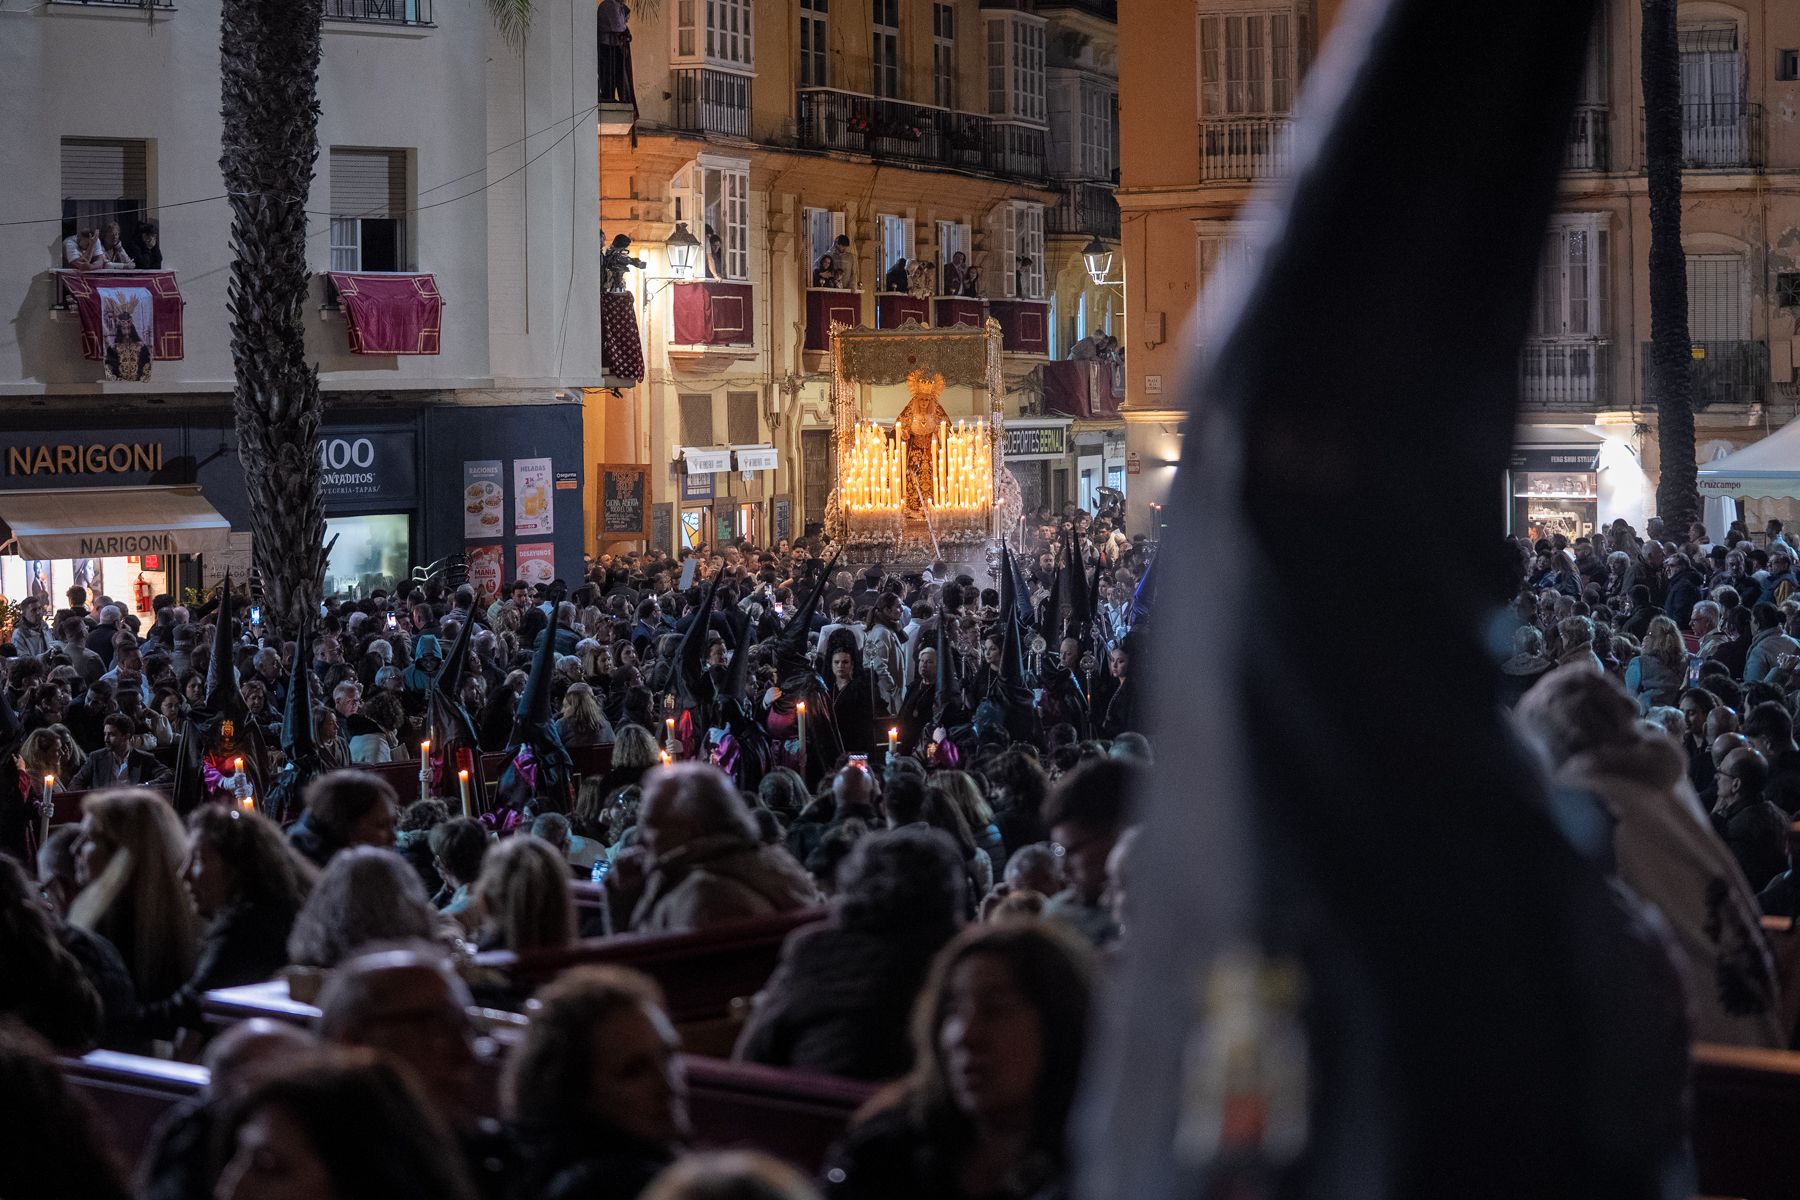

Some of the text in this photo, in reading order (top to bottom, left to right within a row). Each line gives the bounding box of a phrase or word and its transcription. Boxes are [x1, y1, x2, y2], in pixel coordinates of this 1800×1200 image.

[1008, 429, 1063, 453] DEPORTES BERNAL
[10, 443, 162, 475] NARIGONI
[321, 472, 373, 485] ONTADITOS
[1700, 481, 1741, 490] Cruzcampo
[81, 534, 168, 554] NARIGONI
[519, 549, 551, 557] DESAYUNOS
